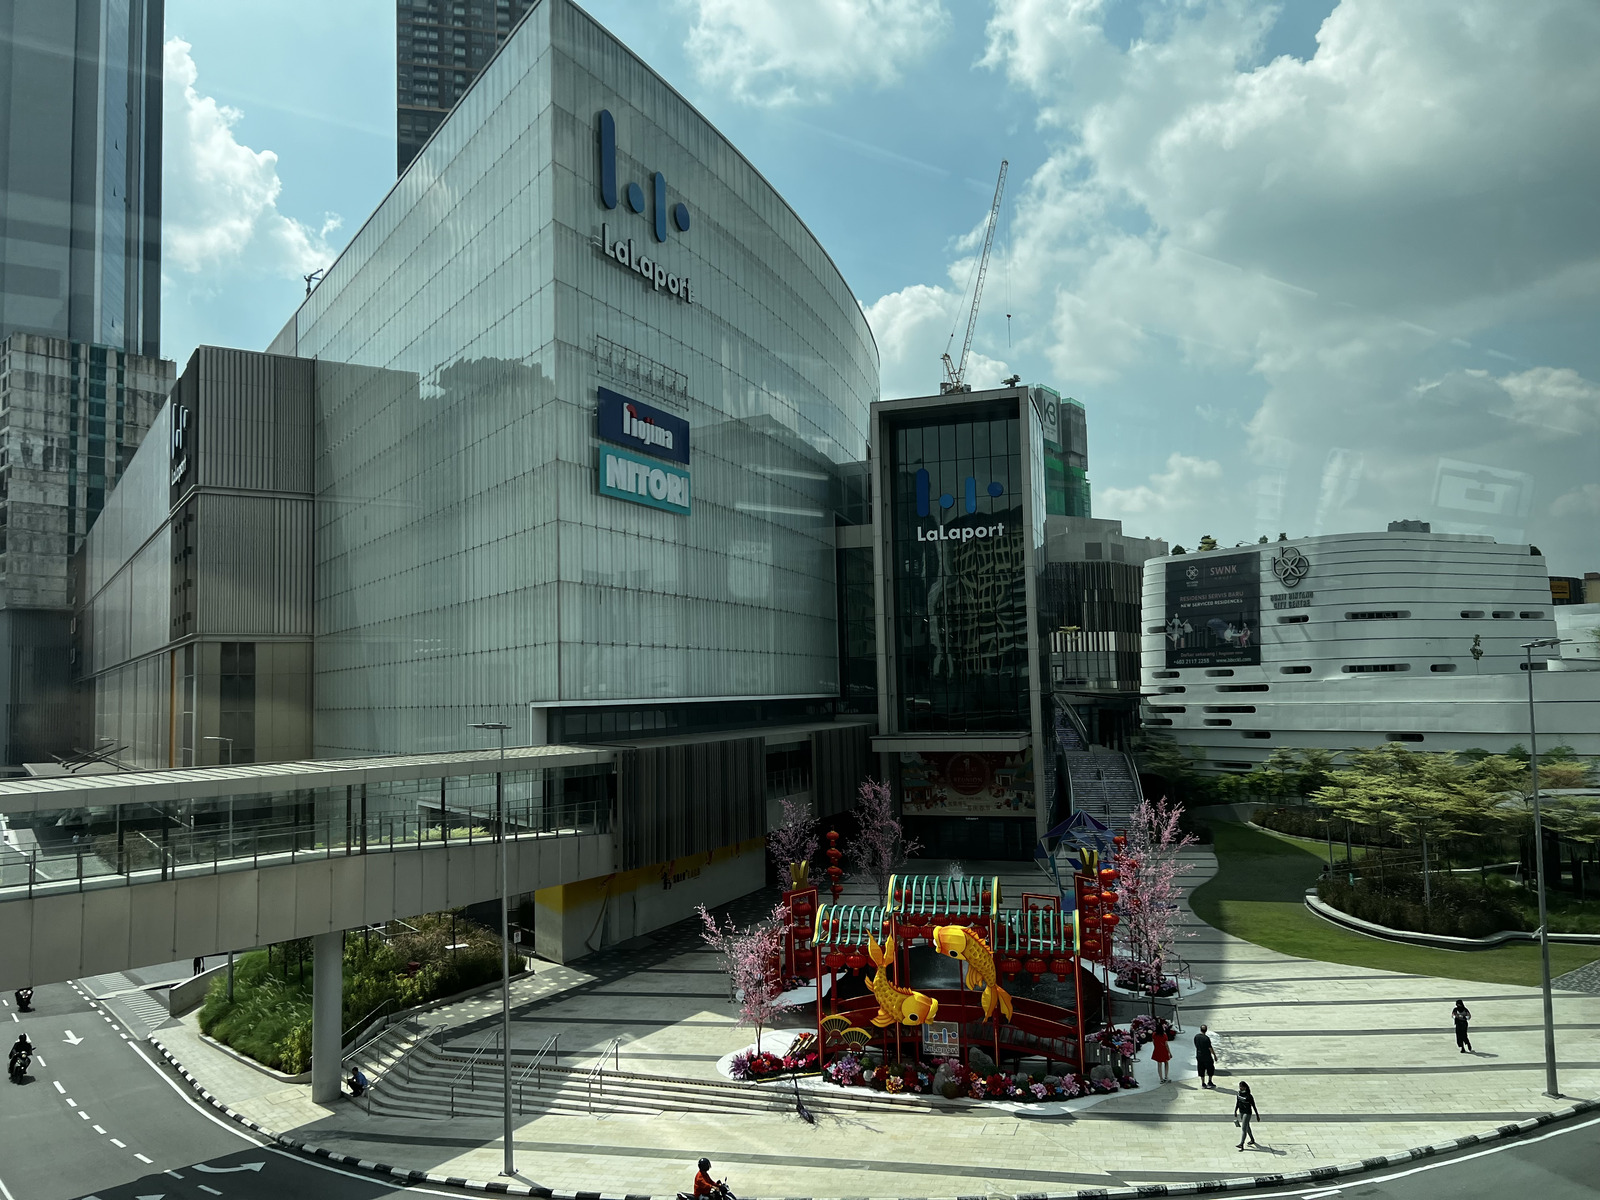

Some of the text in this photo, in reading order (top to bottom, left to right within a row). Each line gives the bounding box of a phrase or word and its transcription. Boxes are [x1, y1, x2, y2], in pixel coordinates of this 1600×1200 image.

[602, 222, 695, 304] LaLaport
[622, 402, 673, 450] nojima
[606, 454, 690, 508] NITORI
[917, 522, 1005, 543] LaLaport
[1210, 565, 1238, 576] SWNK
[1180, 594, 1208, 602] RESIDENSI
[1208, 592, 1228, 600] SERVIS
[1214, 598, 1243, 606] RESIDENCES
